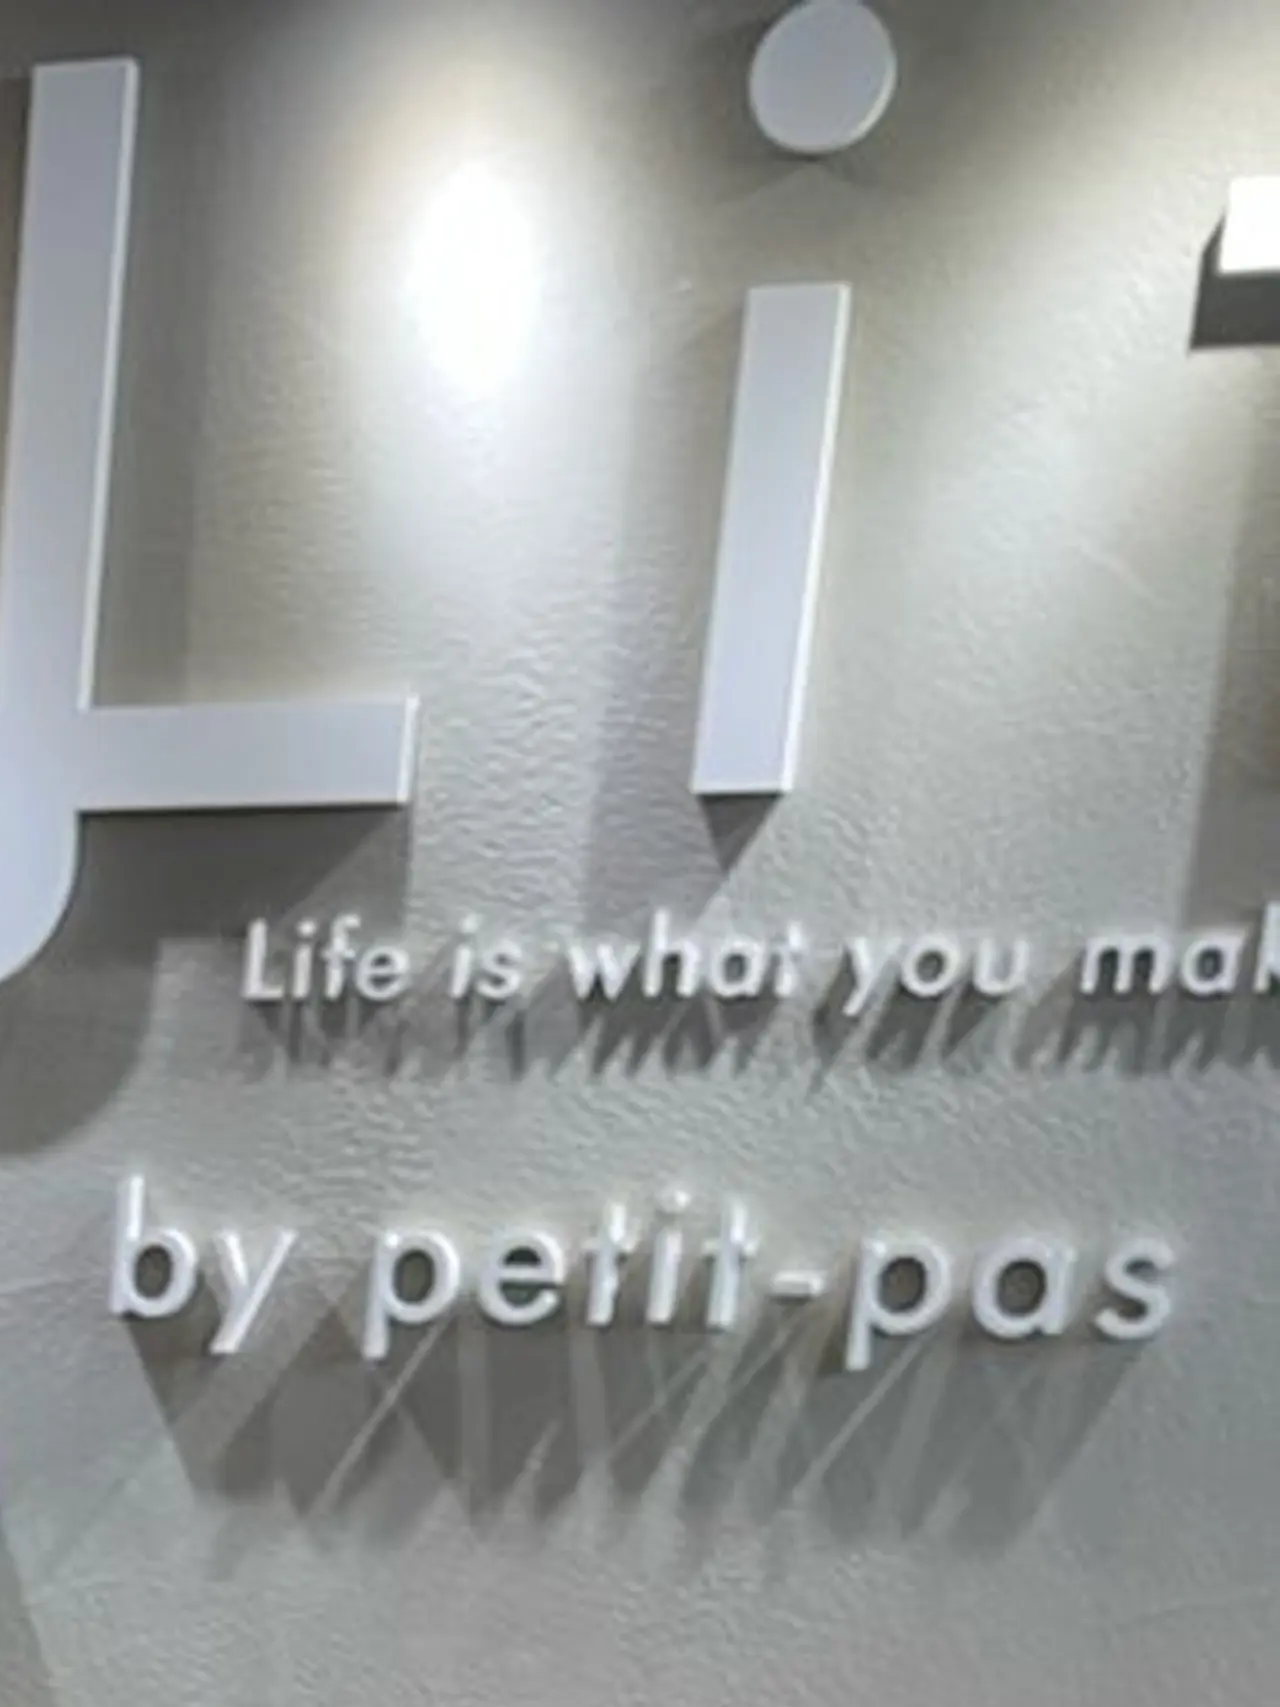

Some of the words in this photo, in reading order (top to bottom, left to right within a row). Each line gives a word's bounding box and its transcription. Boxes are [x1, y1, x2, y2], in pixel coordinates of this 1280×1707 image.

[244, 914, 410, 1001] Life
[448, 914, 523, 999] is
[567, 909, 804, 998] what
[842, 934, 1030, 1017] you
[110, 1174, 298, 1355] by
[361, 1189, 1178, 1372] petit-pas
